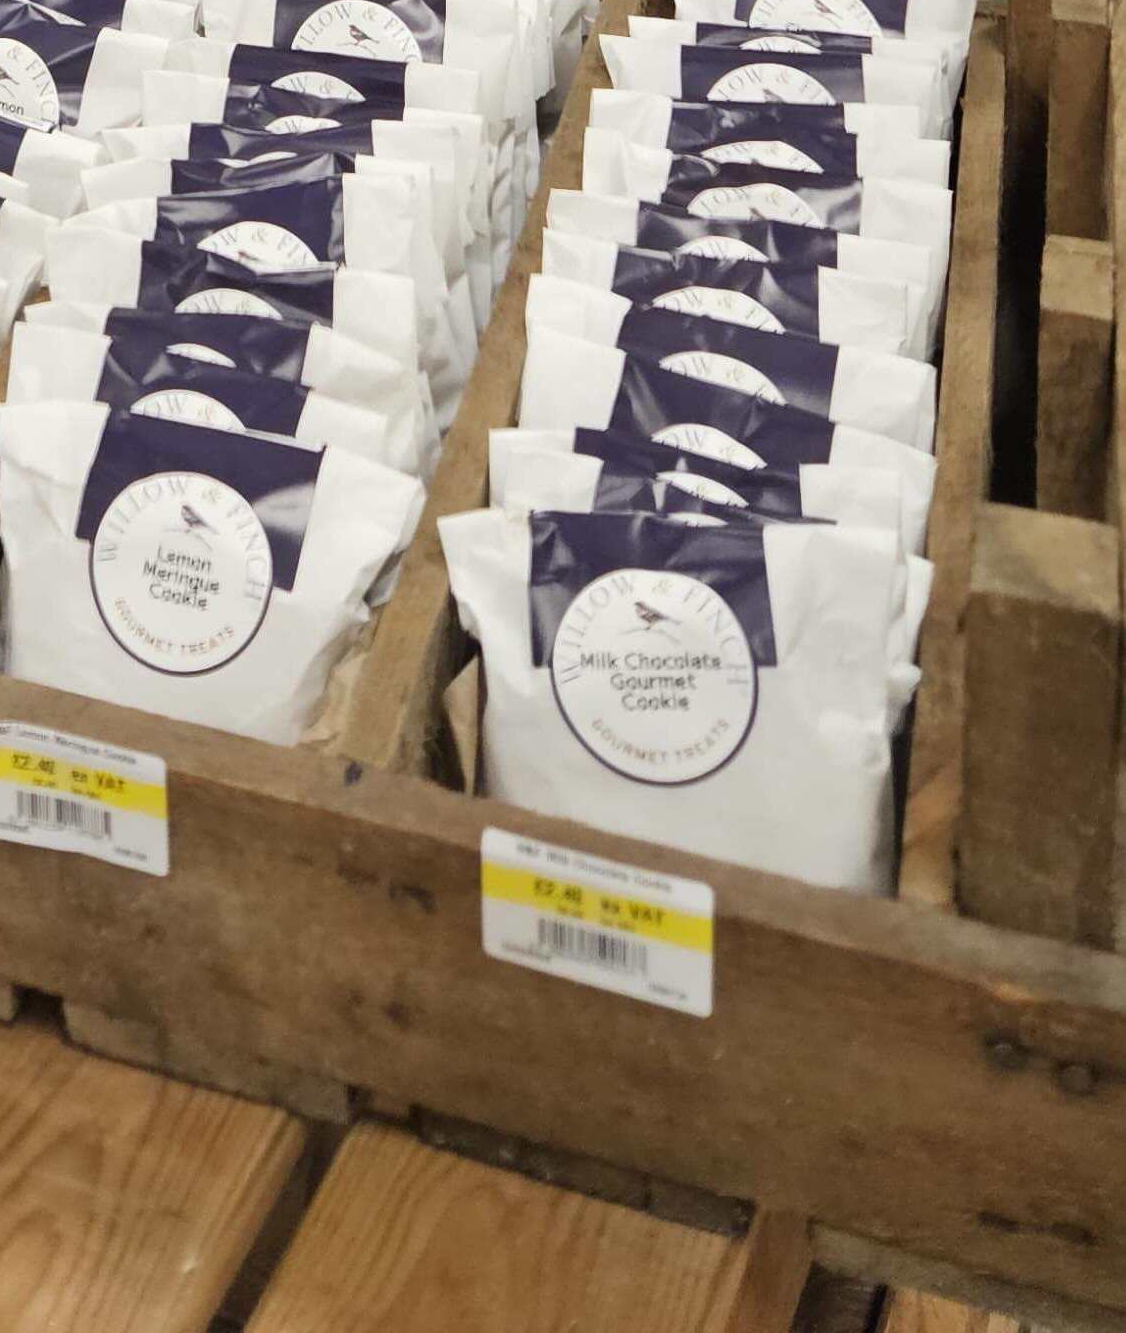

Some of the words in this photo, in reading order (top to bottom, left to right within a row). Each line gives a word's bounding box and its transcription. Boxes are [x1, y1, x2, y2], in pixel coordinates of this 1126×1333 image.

[157, 545, 212, 572] Lemon
[143, 560, 219, 593] Meringue
[149, 583, 208, 611] Cookie
[580, 652, 618, 669] Milk
[624, 653, 722, 671] Chocolate
[610, 673, 697, 691] Gourmet
[621, 693, 690, 711] Cookie
